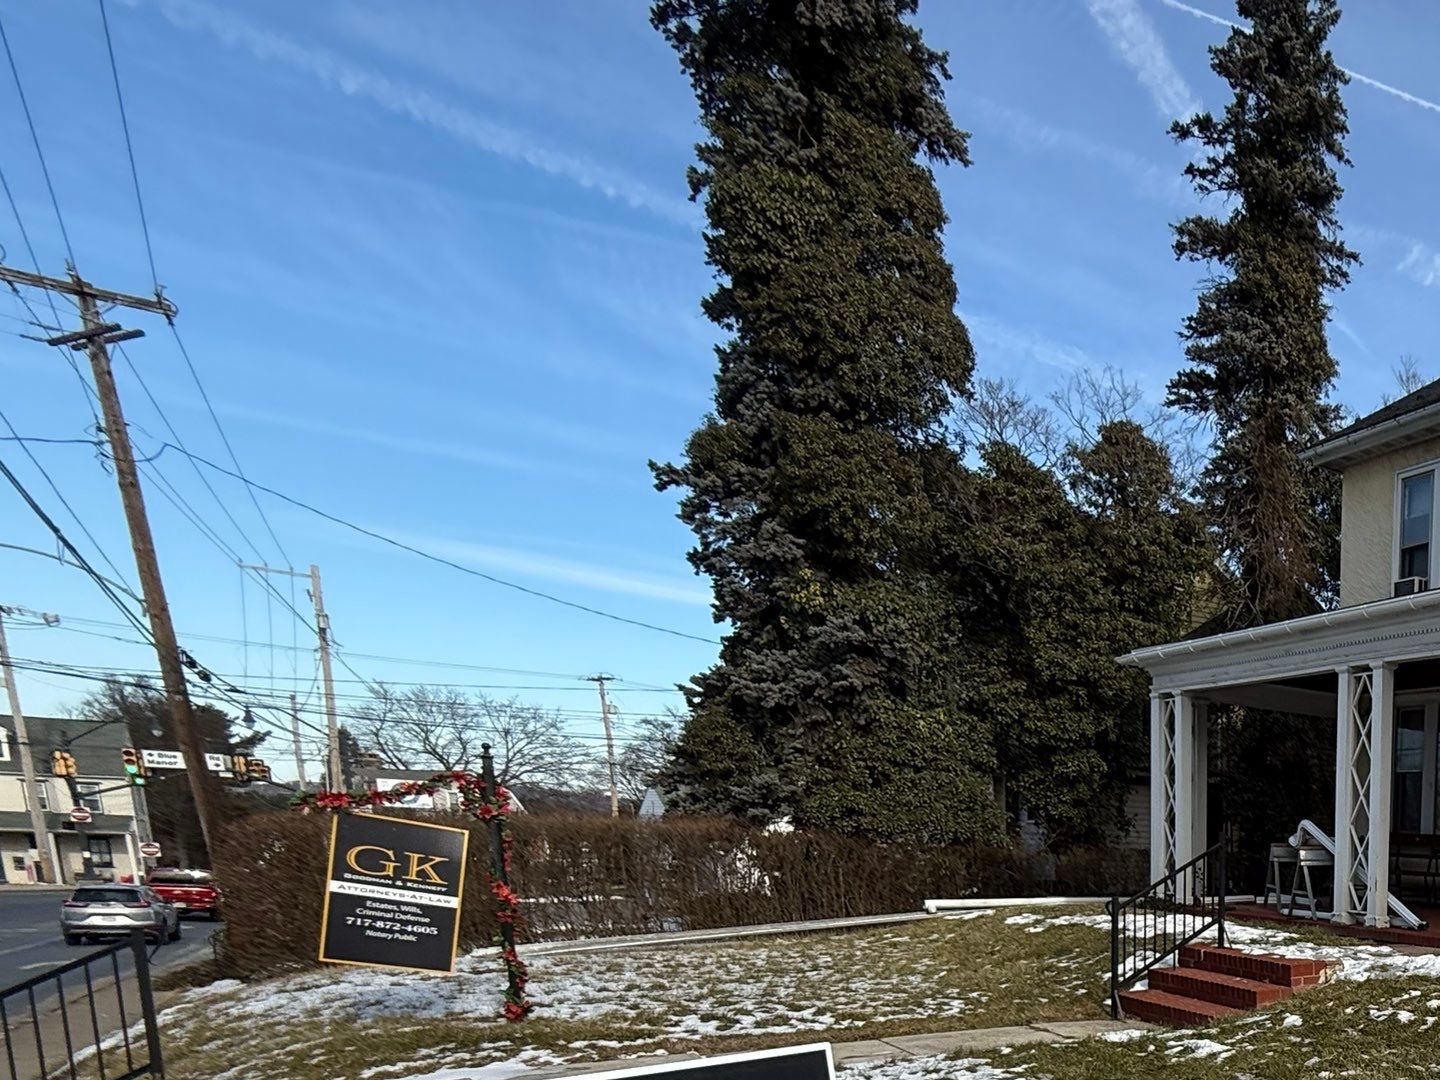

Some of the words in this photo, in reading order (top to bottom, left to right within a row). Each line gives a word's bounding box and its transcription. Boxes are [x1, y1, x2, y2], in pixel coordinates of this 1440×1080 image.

[346, 845, 450, 885] GK
[355, 907, 393, 918] Criminal
[394, 912, 431, 923] Defense
[345, 916, 438, 935] 717-872-4605
[365, 929, 394, 940] Notary
[393, 932, 418, 942] Public
